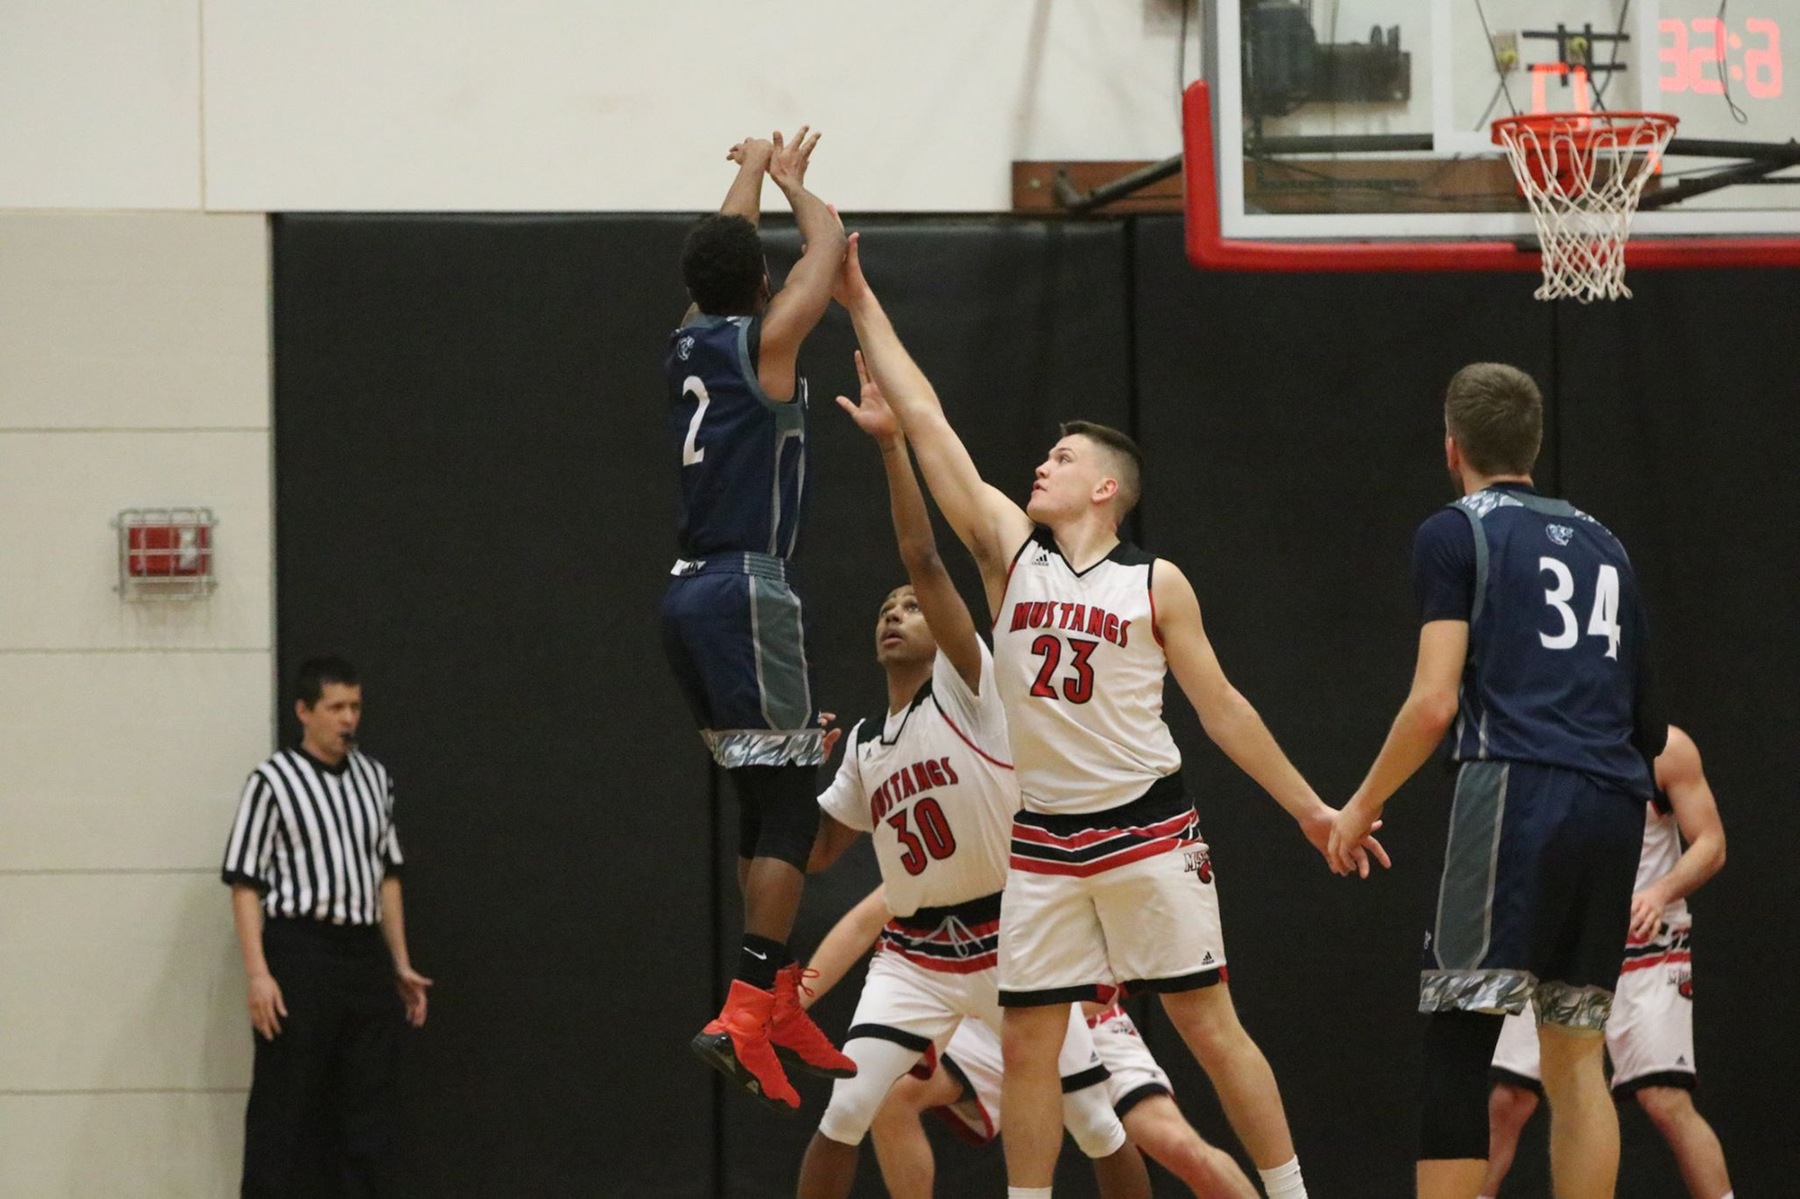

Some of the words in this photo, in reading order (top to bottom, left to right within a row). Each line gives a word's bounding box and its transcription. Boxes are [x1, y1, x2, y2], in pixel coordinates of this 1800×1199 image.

[682, 375, 711, 467] 2
[1009, 600, 1132, 649] MUSTANGS
[1538, 556, 1621, 662] 34
[1029, 634, 1100, 704] 23
[886, 797, 957, 876] 30
